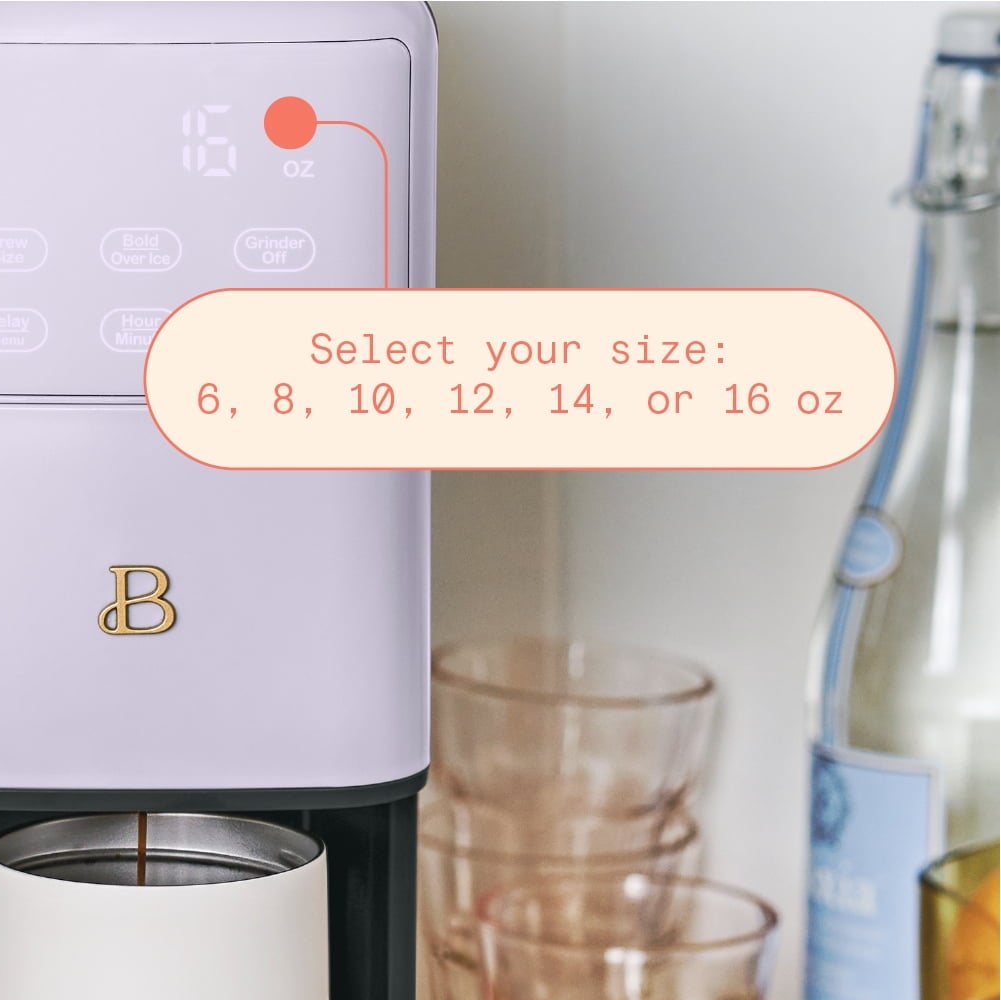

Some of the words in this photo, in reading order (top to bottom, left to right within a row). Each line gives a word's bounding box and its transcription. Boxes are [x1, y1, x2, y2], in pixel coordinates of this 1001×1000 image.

[182, 104, 237, 176] 16
[122, 234, 159, 248] Bold
[245, 236, 305, 249] Grinder
[111, 252, 146, 265] Over
[149, 252, 170, 265] Ice
[262, 250, 287, 265] Off
[121, 314, 162, 327] Hour
[115, 332, 153, 346] Minu
[98, 565, 177, 635] B
